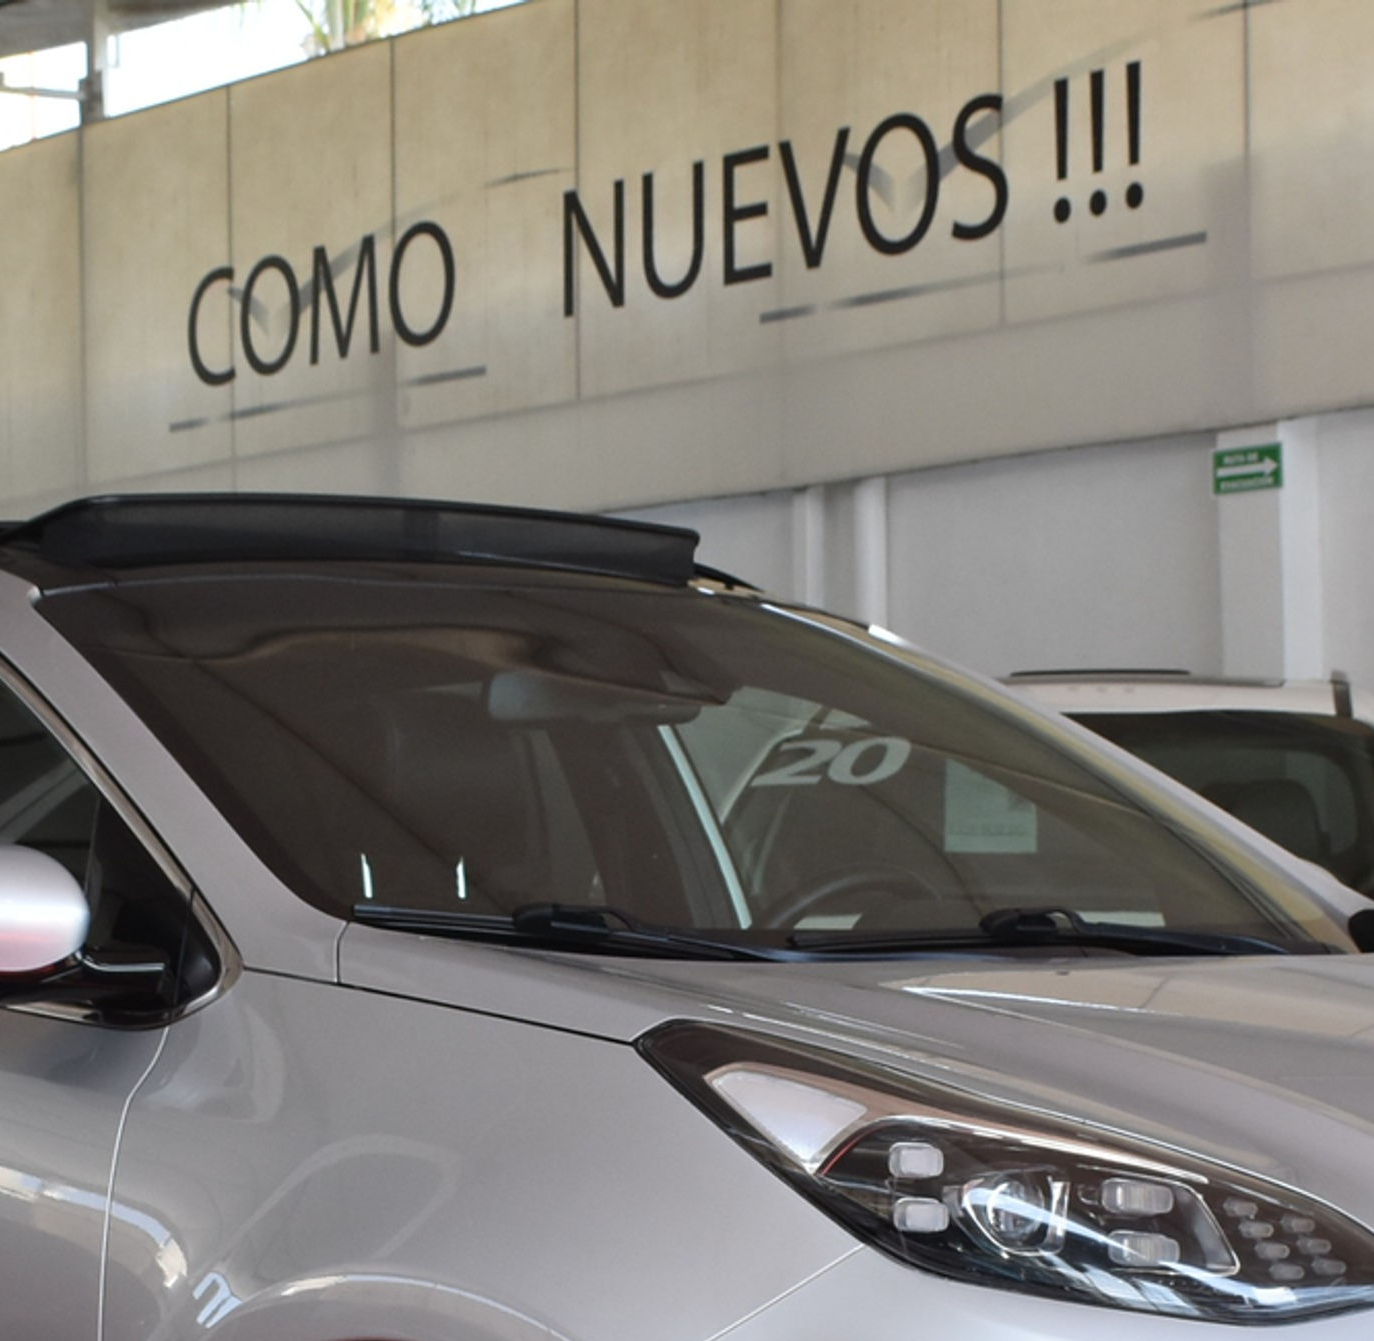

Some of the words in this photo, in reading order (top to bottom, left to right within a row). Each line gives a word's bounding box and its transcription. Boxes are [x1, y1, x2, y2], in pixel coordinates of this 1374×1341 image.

[188, 220, 456, 386] COMO
[563, 93, 1009, 317] NUEVOS
[1053, 60, 1143, 224] !!!
[749, 736, 912, 787] 20
